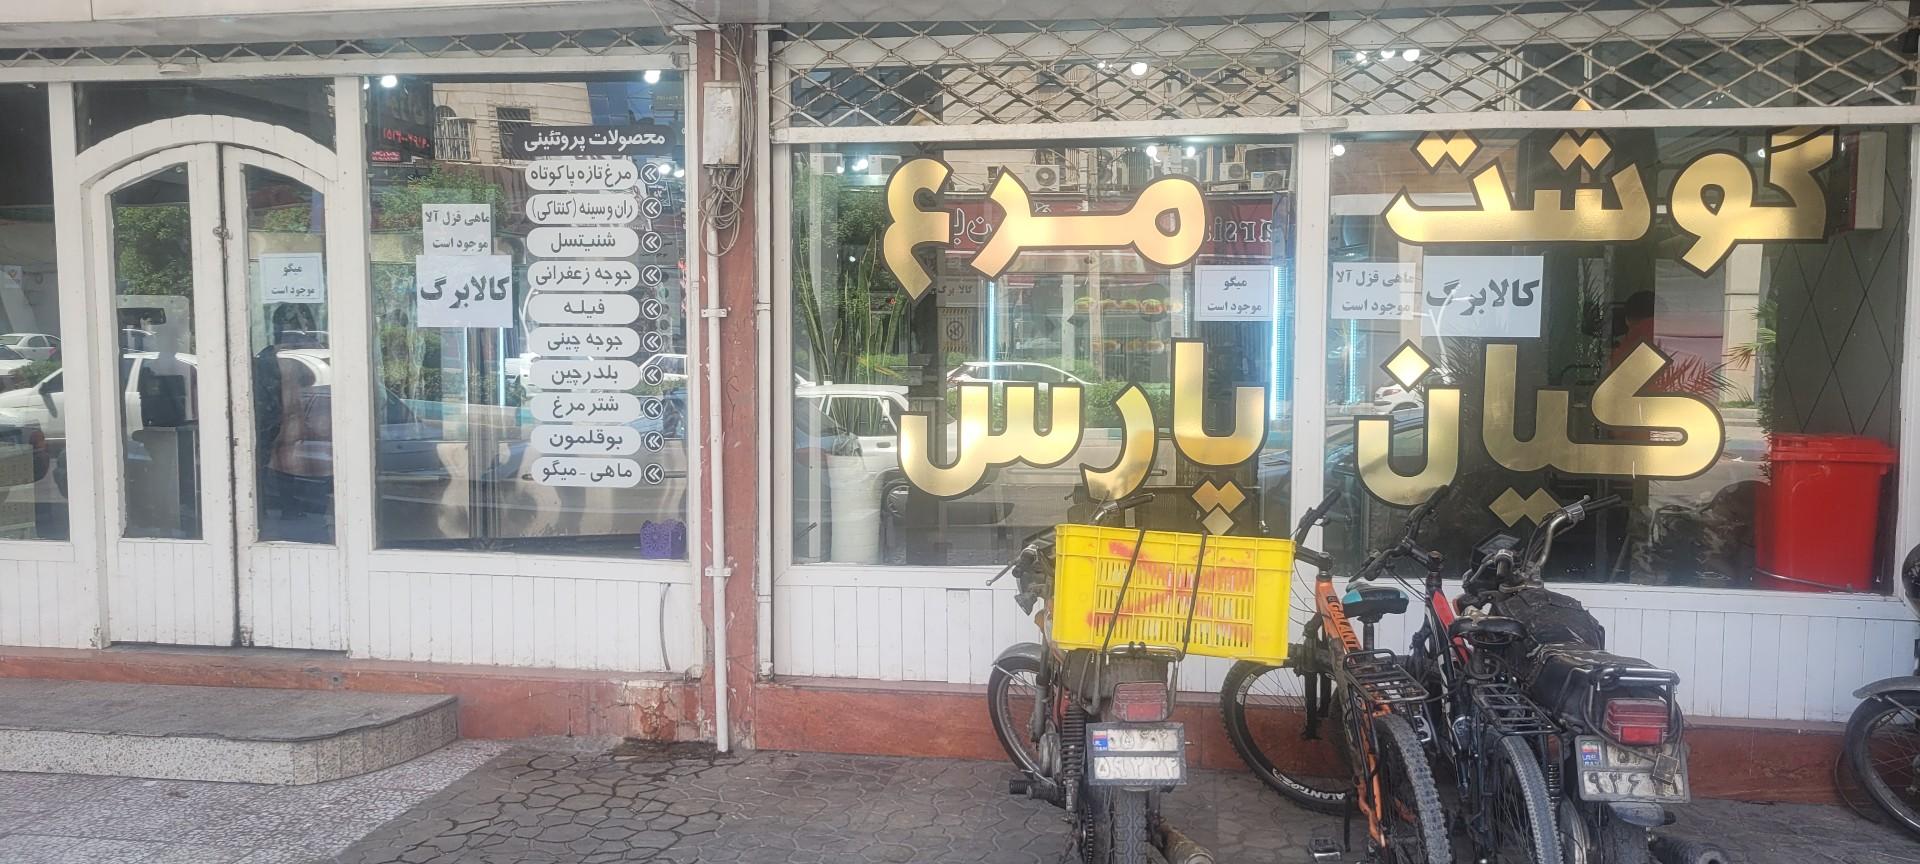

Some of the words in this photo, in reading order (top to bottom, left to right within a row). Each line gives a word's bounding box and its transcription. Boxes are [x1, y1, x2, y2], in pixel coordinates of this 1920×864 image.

[524, 130, 586, 151] پروتئینی
[588, 129, 666, 152] محصولات
[578, 165, 603, 184] تازه
[604, 163, 632, 187] مرغ
[1382, 98, 1840, 278] گوشت
[425, 210, 440, 222] آلا
[442, 210, 462, 226] قزل
[532, 198, 577, 221] (کنتاکی)
[579, 203, 606, 220] سینه
[606, 206, 614, 220] و
[614, 199, 633, 218] ران
[464, 211, 490, 226] ماهی
[432, 237, 454, 249] است
[456, 238, 489, 252] موجود
[283, 263, 303, 276] میگو
[535, 265, 590, 286] زعفرانی
[594, 268, 632, 287] جوجه
[1336, 269, 1353, 283] آلا
[1355, 270, 1379, 287] قزل
[1223, 275, 1248, 291] میگو
[1382, 272, 1414, 287] ماهی
[272, 286, 288, 295] است
[290, 287, 315, 297] موجود
[420, 275, 510, 309] کالابرگ
[1426, 278, 1540, 316] کالابرگ
[563, 299, 605, 319] فیله
[1207, 301, 1228, 312] است
[1230, 302, 1262, 315] موجود
[1342, 299, 1368, 311] است
[1371, 301, 1411, 316] موجود
[547, 332, 581, 352] چینی
[586, 333, 623, 352] جوجه
[551, 365, 619, 386] بلدرچین
[549, 429, 623, 451] بوقلمون
[899, 338, 1269, 536] پارس
[1354, 339, 1726, 529] کیان
[542, 459, 577, 482] میگو
[590, 463, 633, 483] ماهی
